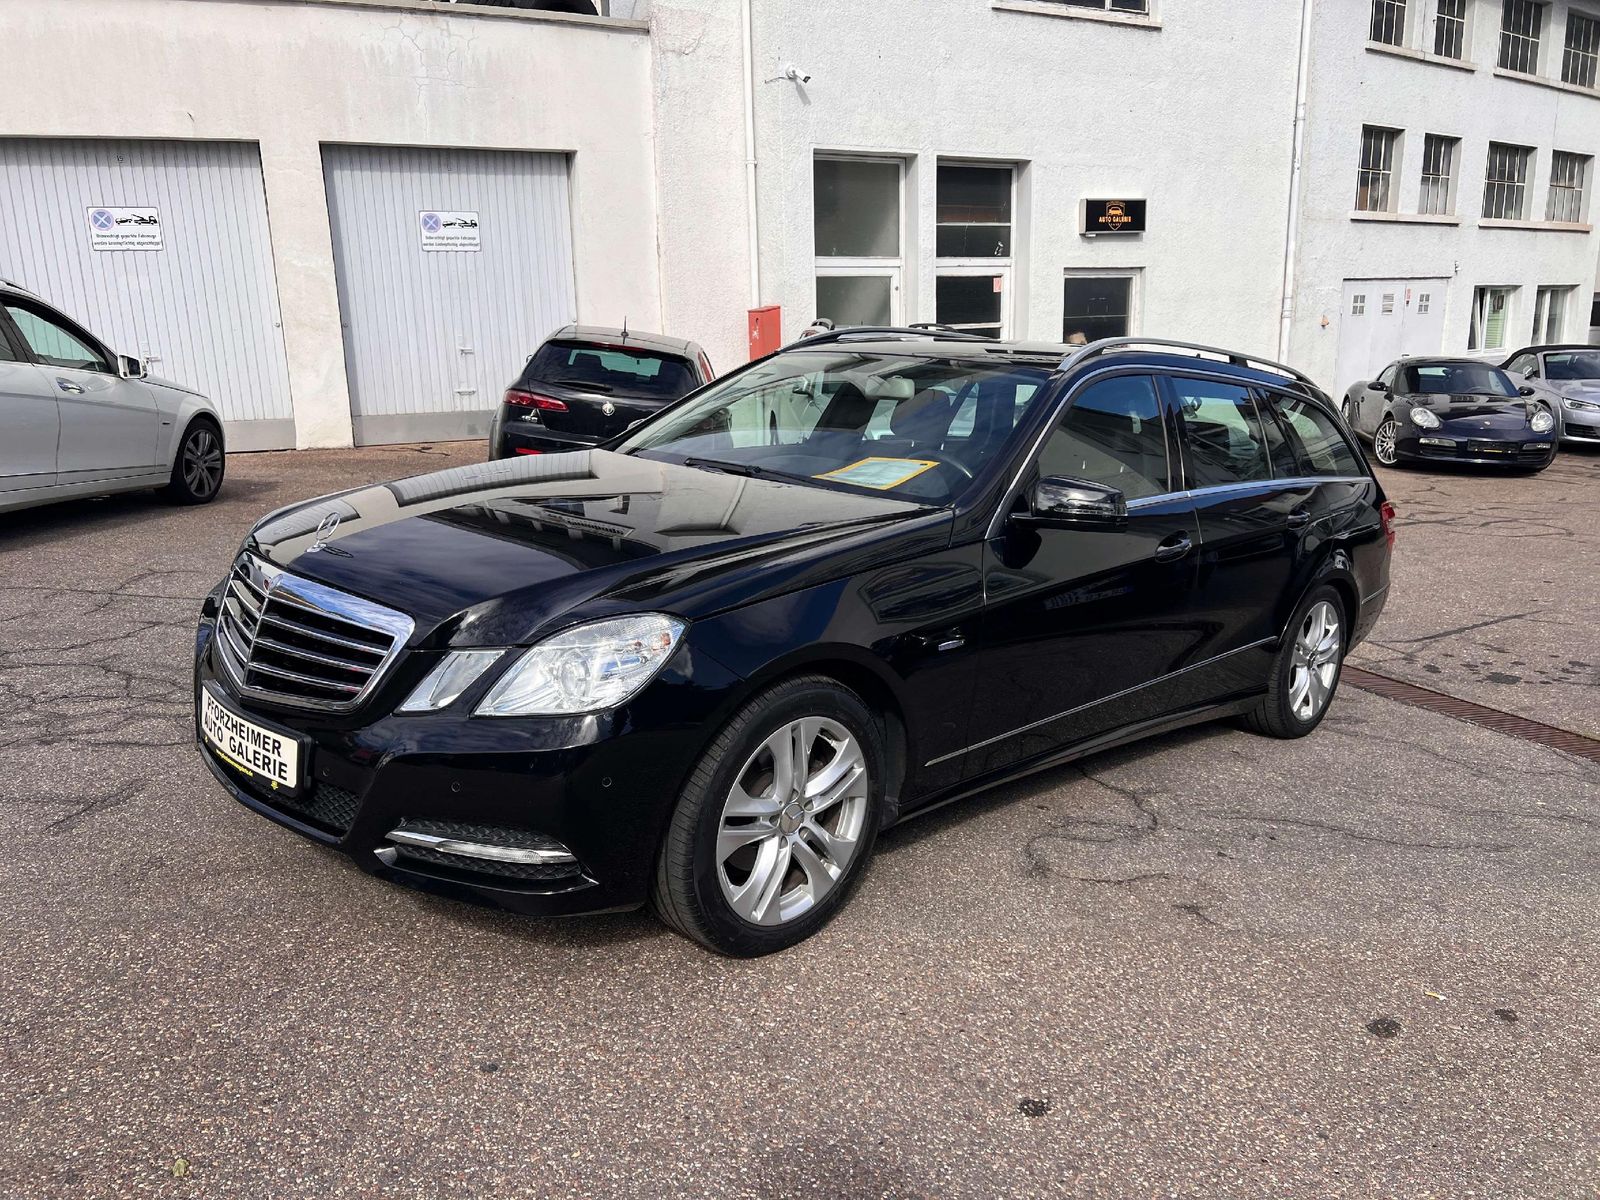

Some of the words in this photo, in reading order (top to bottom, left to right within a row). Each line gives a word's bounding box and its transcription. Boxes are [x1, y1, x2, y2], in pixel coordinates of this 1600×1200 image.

[204, 712, 224, 743] AUTO
[229, 736, 287, 781] GALERIE
[207, 695, 282, 757] PFORZHEIMER
